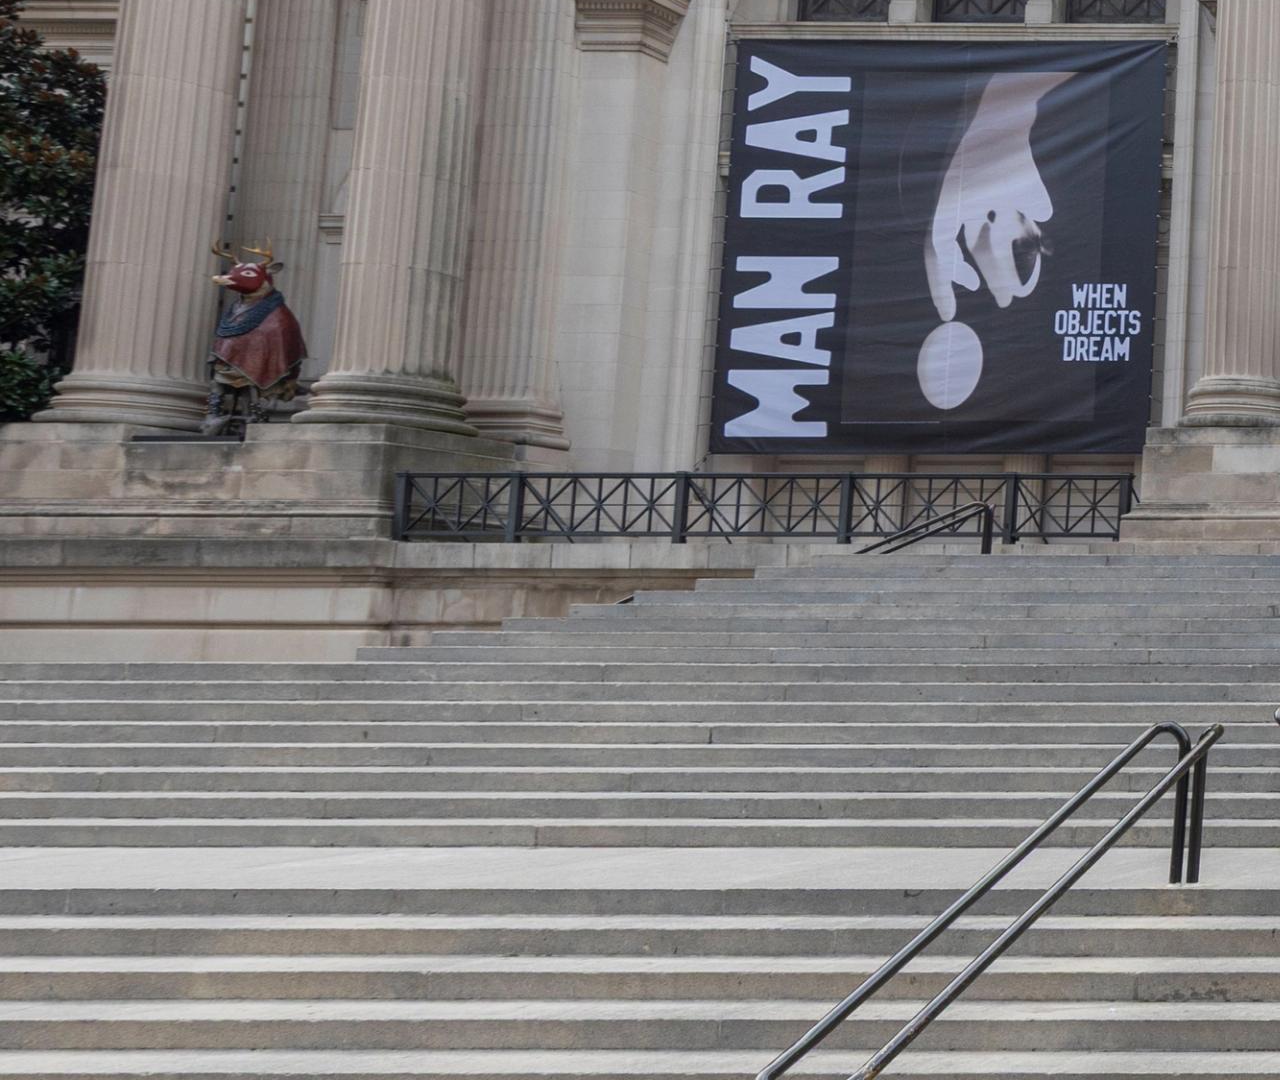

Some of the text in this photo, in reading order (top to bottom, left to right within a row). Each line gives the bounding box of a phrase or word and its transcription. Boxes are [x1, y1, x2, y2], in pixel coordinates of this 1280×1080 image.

[724, 55, 852, 438] MAN RAY
[1072, 283, 1127, 308] WHEN
[1054, 309, 1141, 335] OBJECTS
[1063, 336, 1130, 362] DREAM
